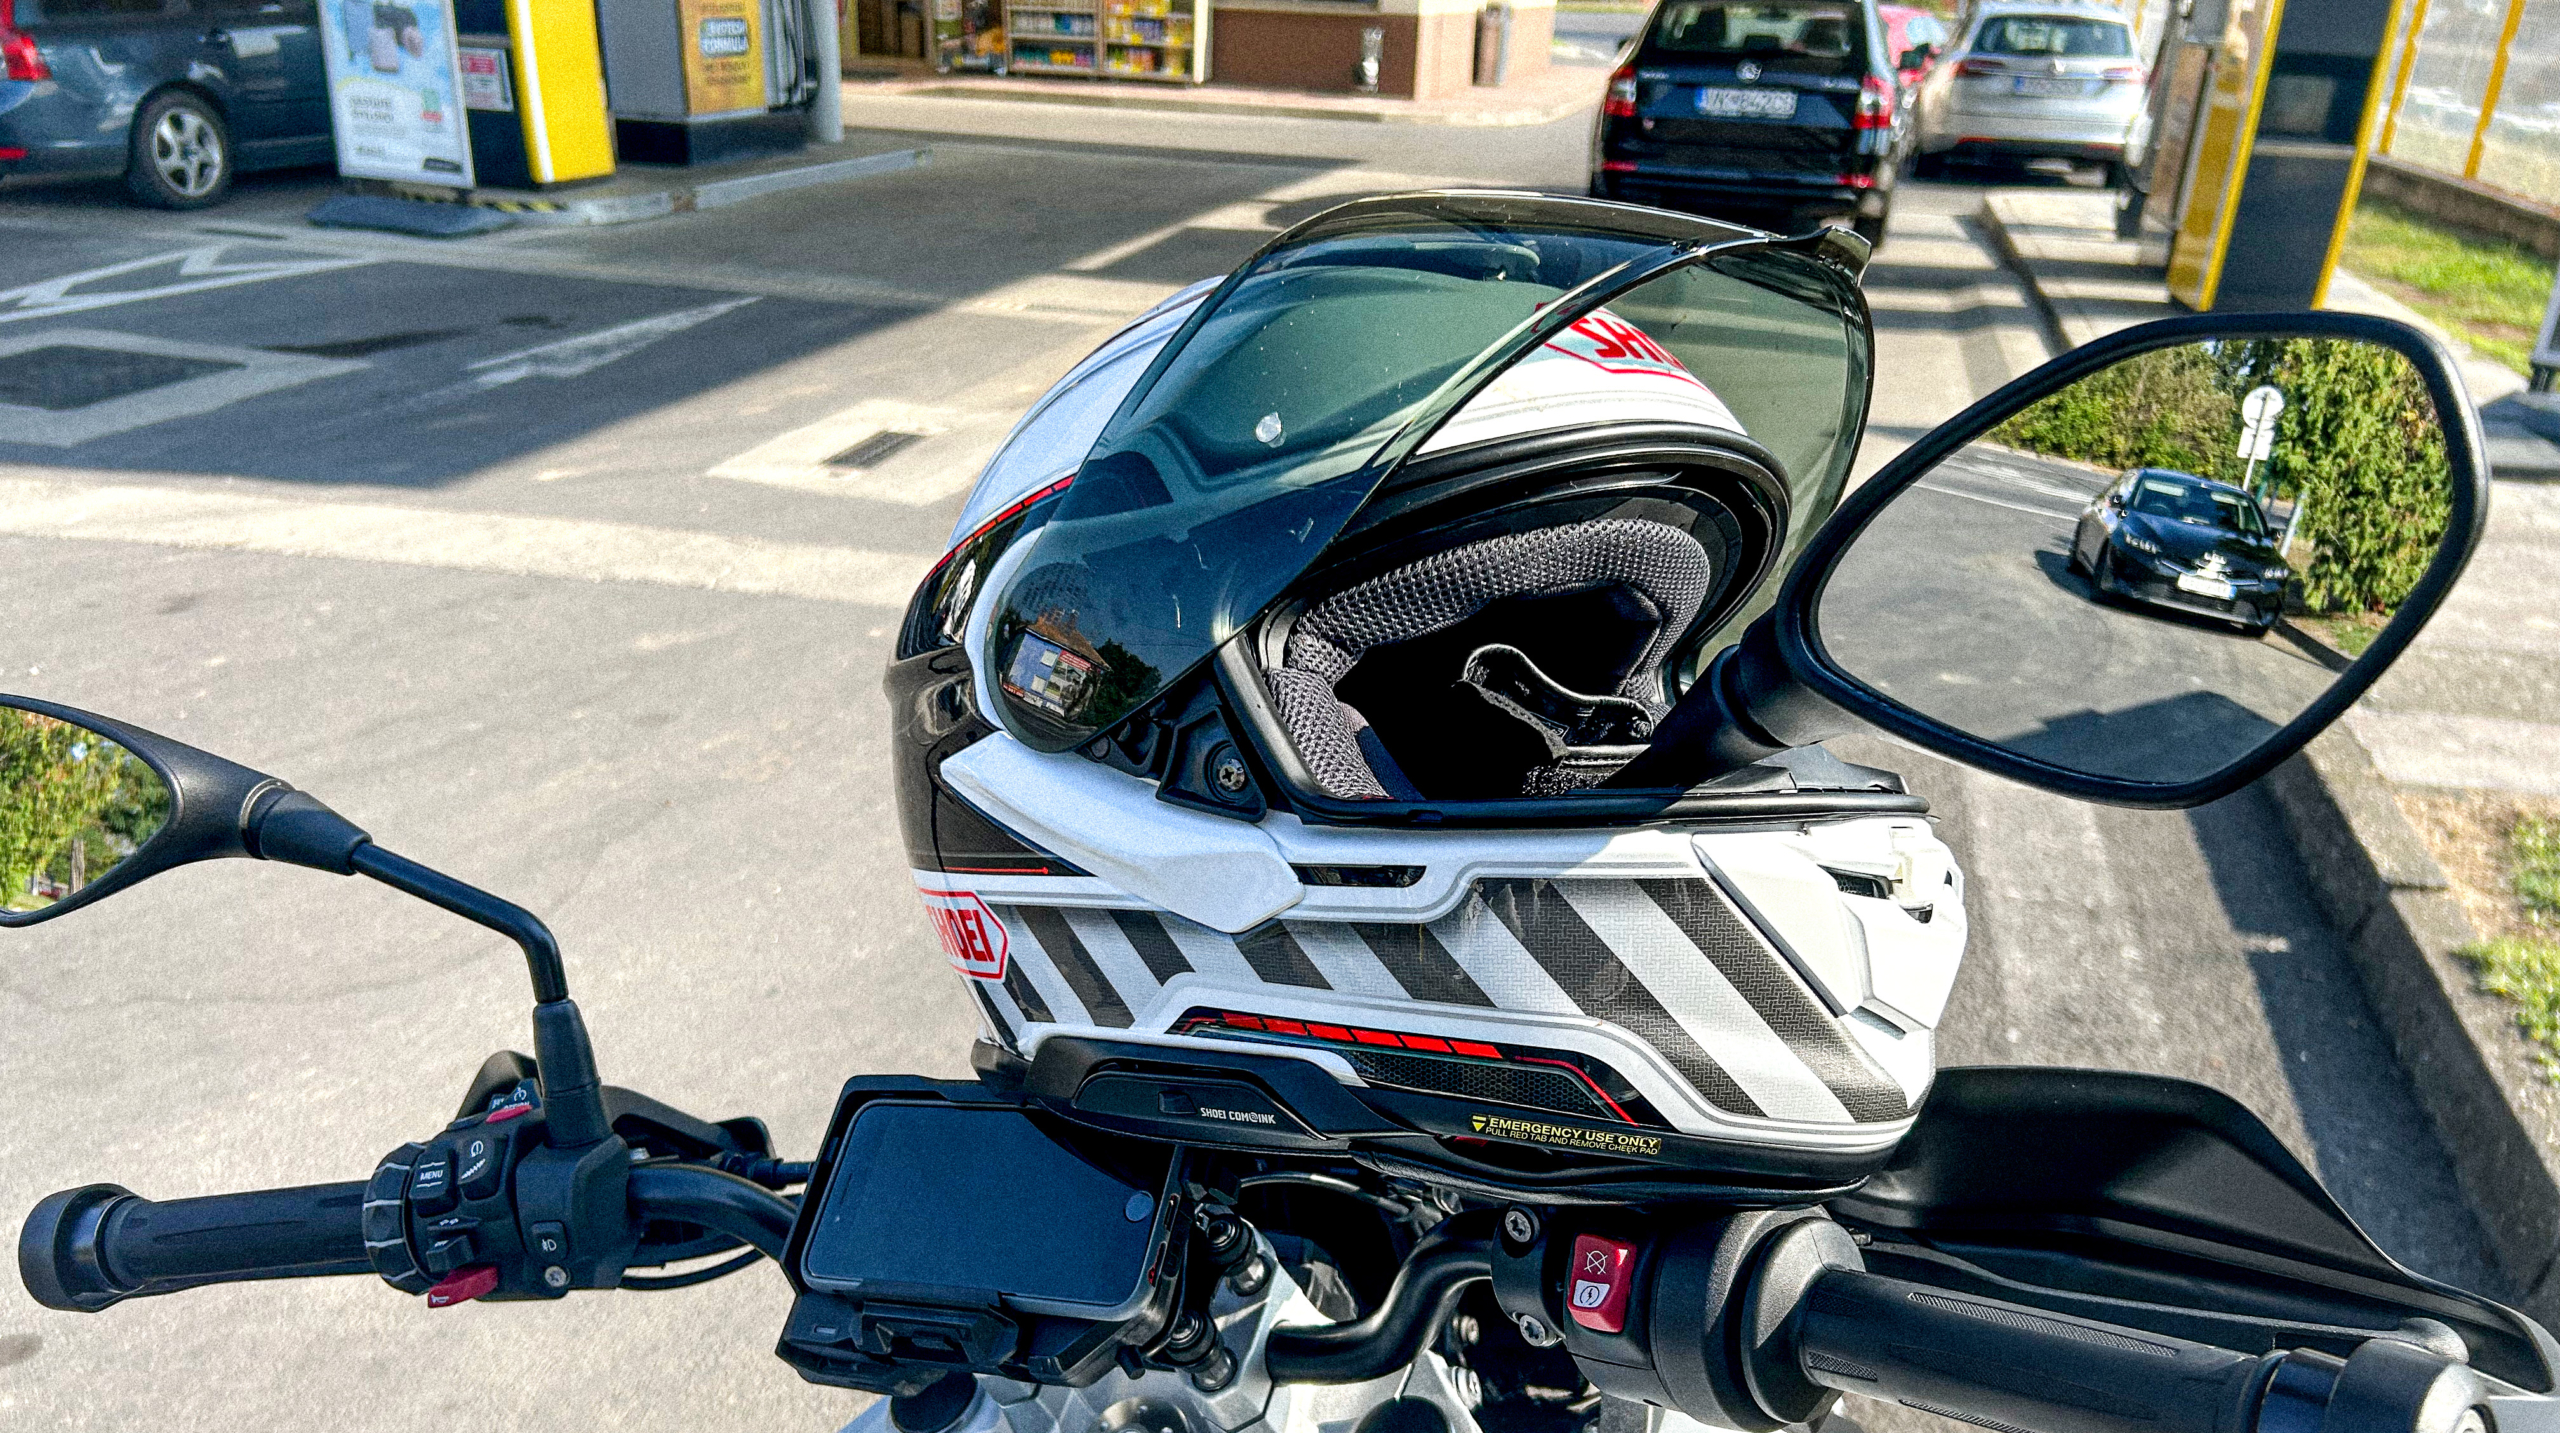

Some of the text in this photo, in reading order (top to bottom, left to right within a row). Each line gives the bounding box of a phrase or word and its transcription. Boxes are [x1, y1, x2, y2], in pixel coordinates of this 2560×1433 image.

[1566, 313, 1689, 373] SHO
[1200, 1107, 1227, 1120] SHOEI
[1485, 1126, 1658, 1155] PULL RED TAB AND REMOVE CHEEK PAD
[1489, 1117, 1658, 1148] EMERGENCY USE ONLY
[420, 1169, 444, 1181] MENU
